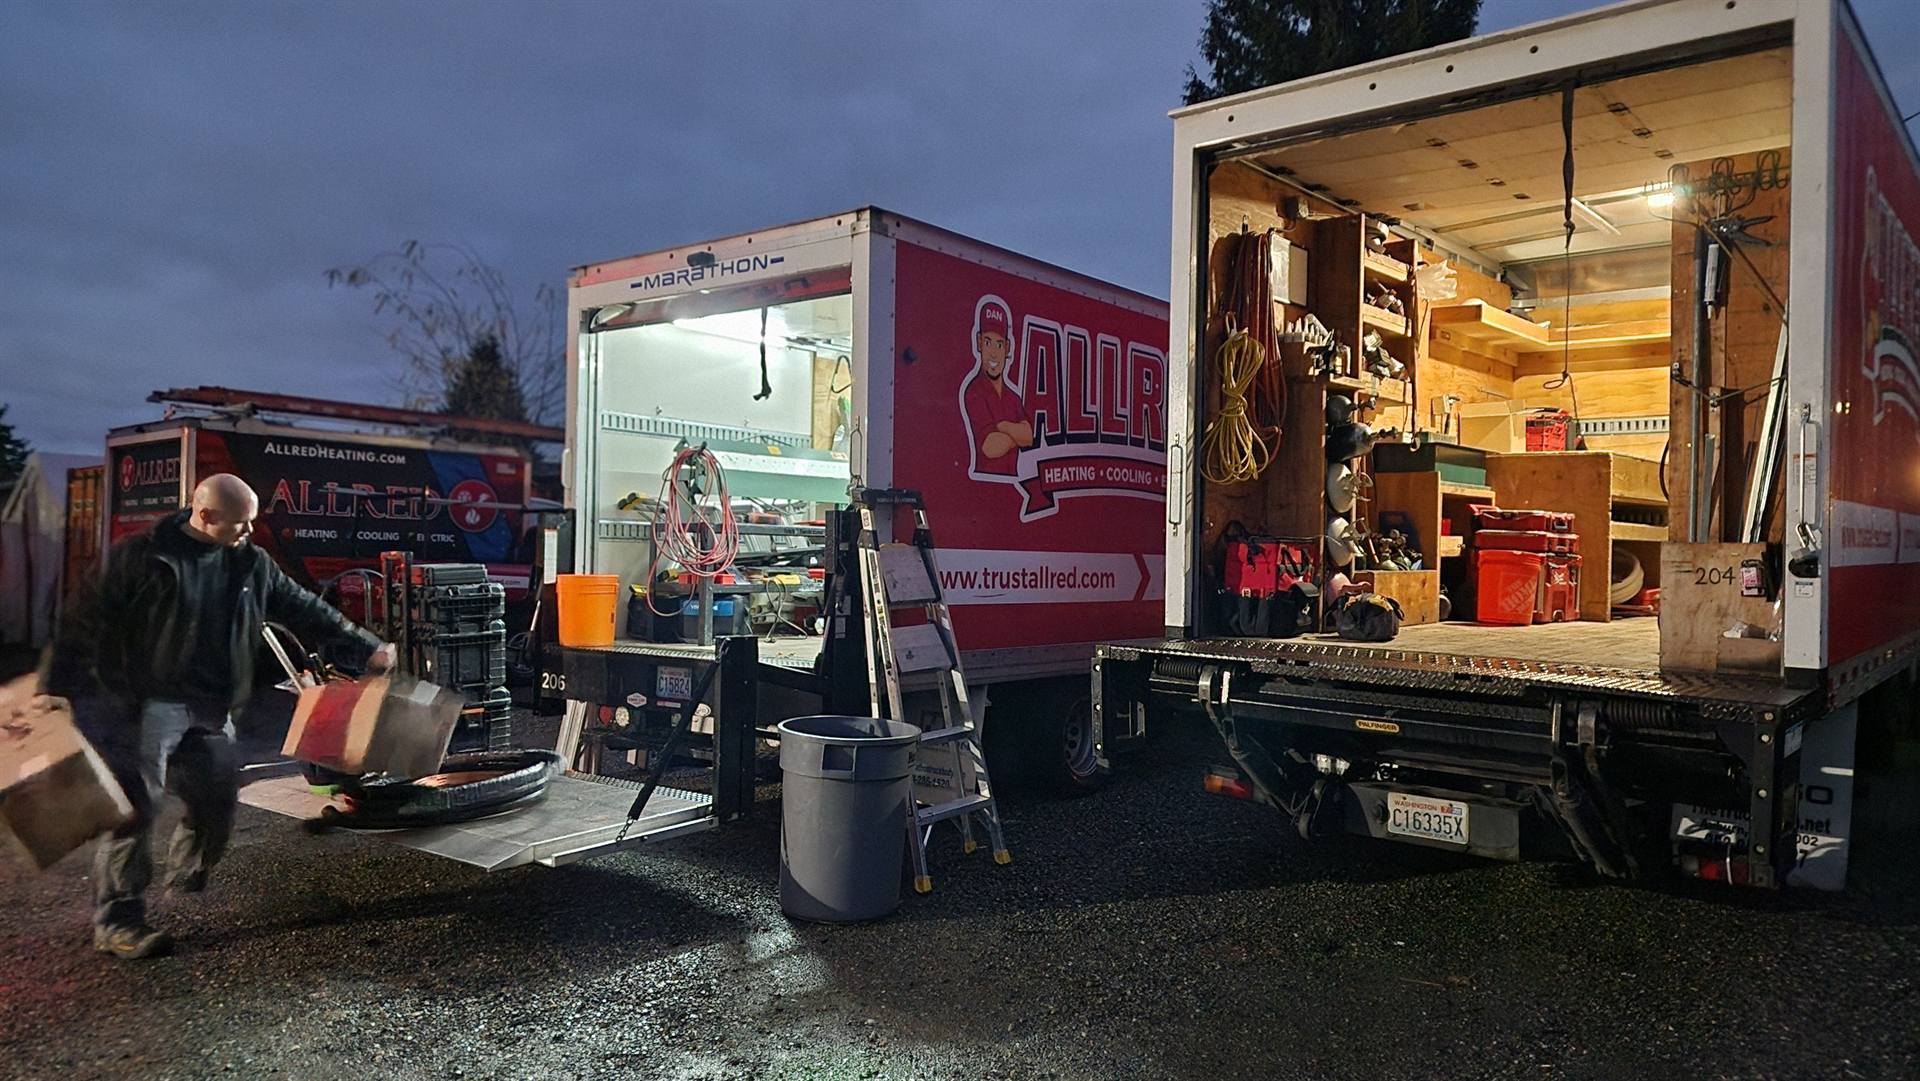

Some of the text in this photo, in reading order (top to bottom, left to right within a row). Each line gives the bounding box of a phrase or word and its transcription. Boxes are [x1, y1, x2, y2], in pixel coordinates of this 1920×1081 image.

[986, 309, 1003, 322] DAN
[1021, 319, 1168, 453] ALLR
[1044, 466, 1096, 484] HEATING
[1106, 467, 1152, 485] COOLING
[264, 478, 442, 521] ALLRED
[294, 529, 339, 540] HEATING
[356, 530, 400, 541] COOLING
[939, 566, 1116, 590] ww.trustallred.com
[1694, 567, 1736, 585] 204
[541, 672, 566, 691] 206
[1357, 720, 1398, 731] PALFINGER
[1394, 800, 1438, 811] WASHINGTON
[1393, 808, 1463, 838] C16335X
